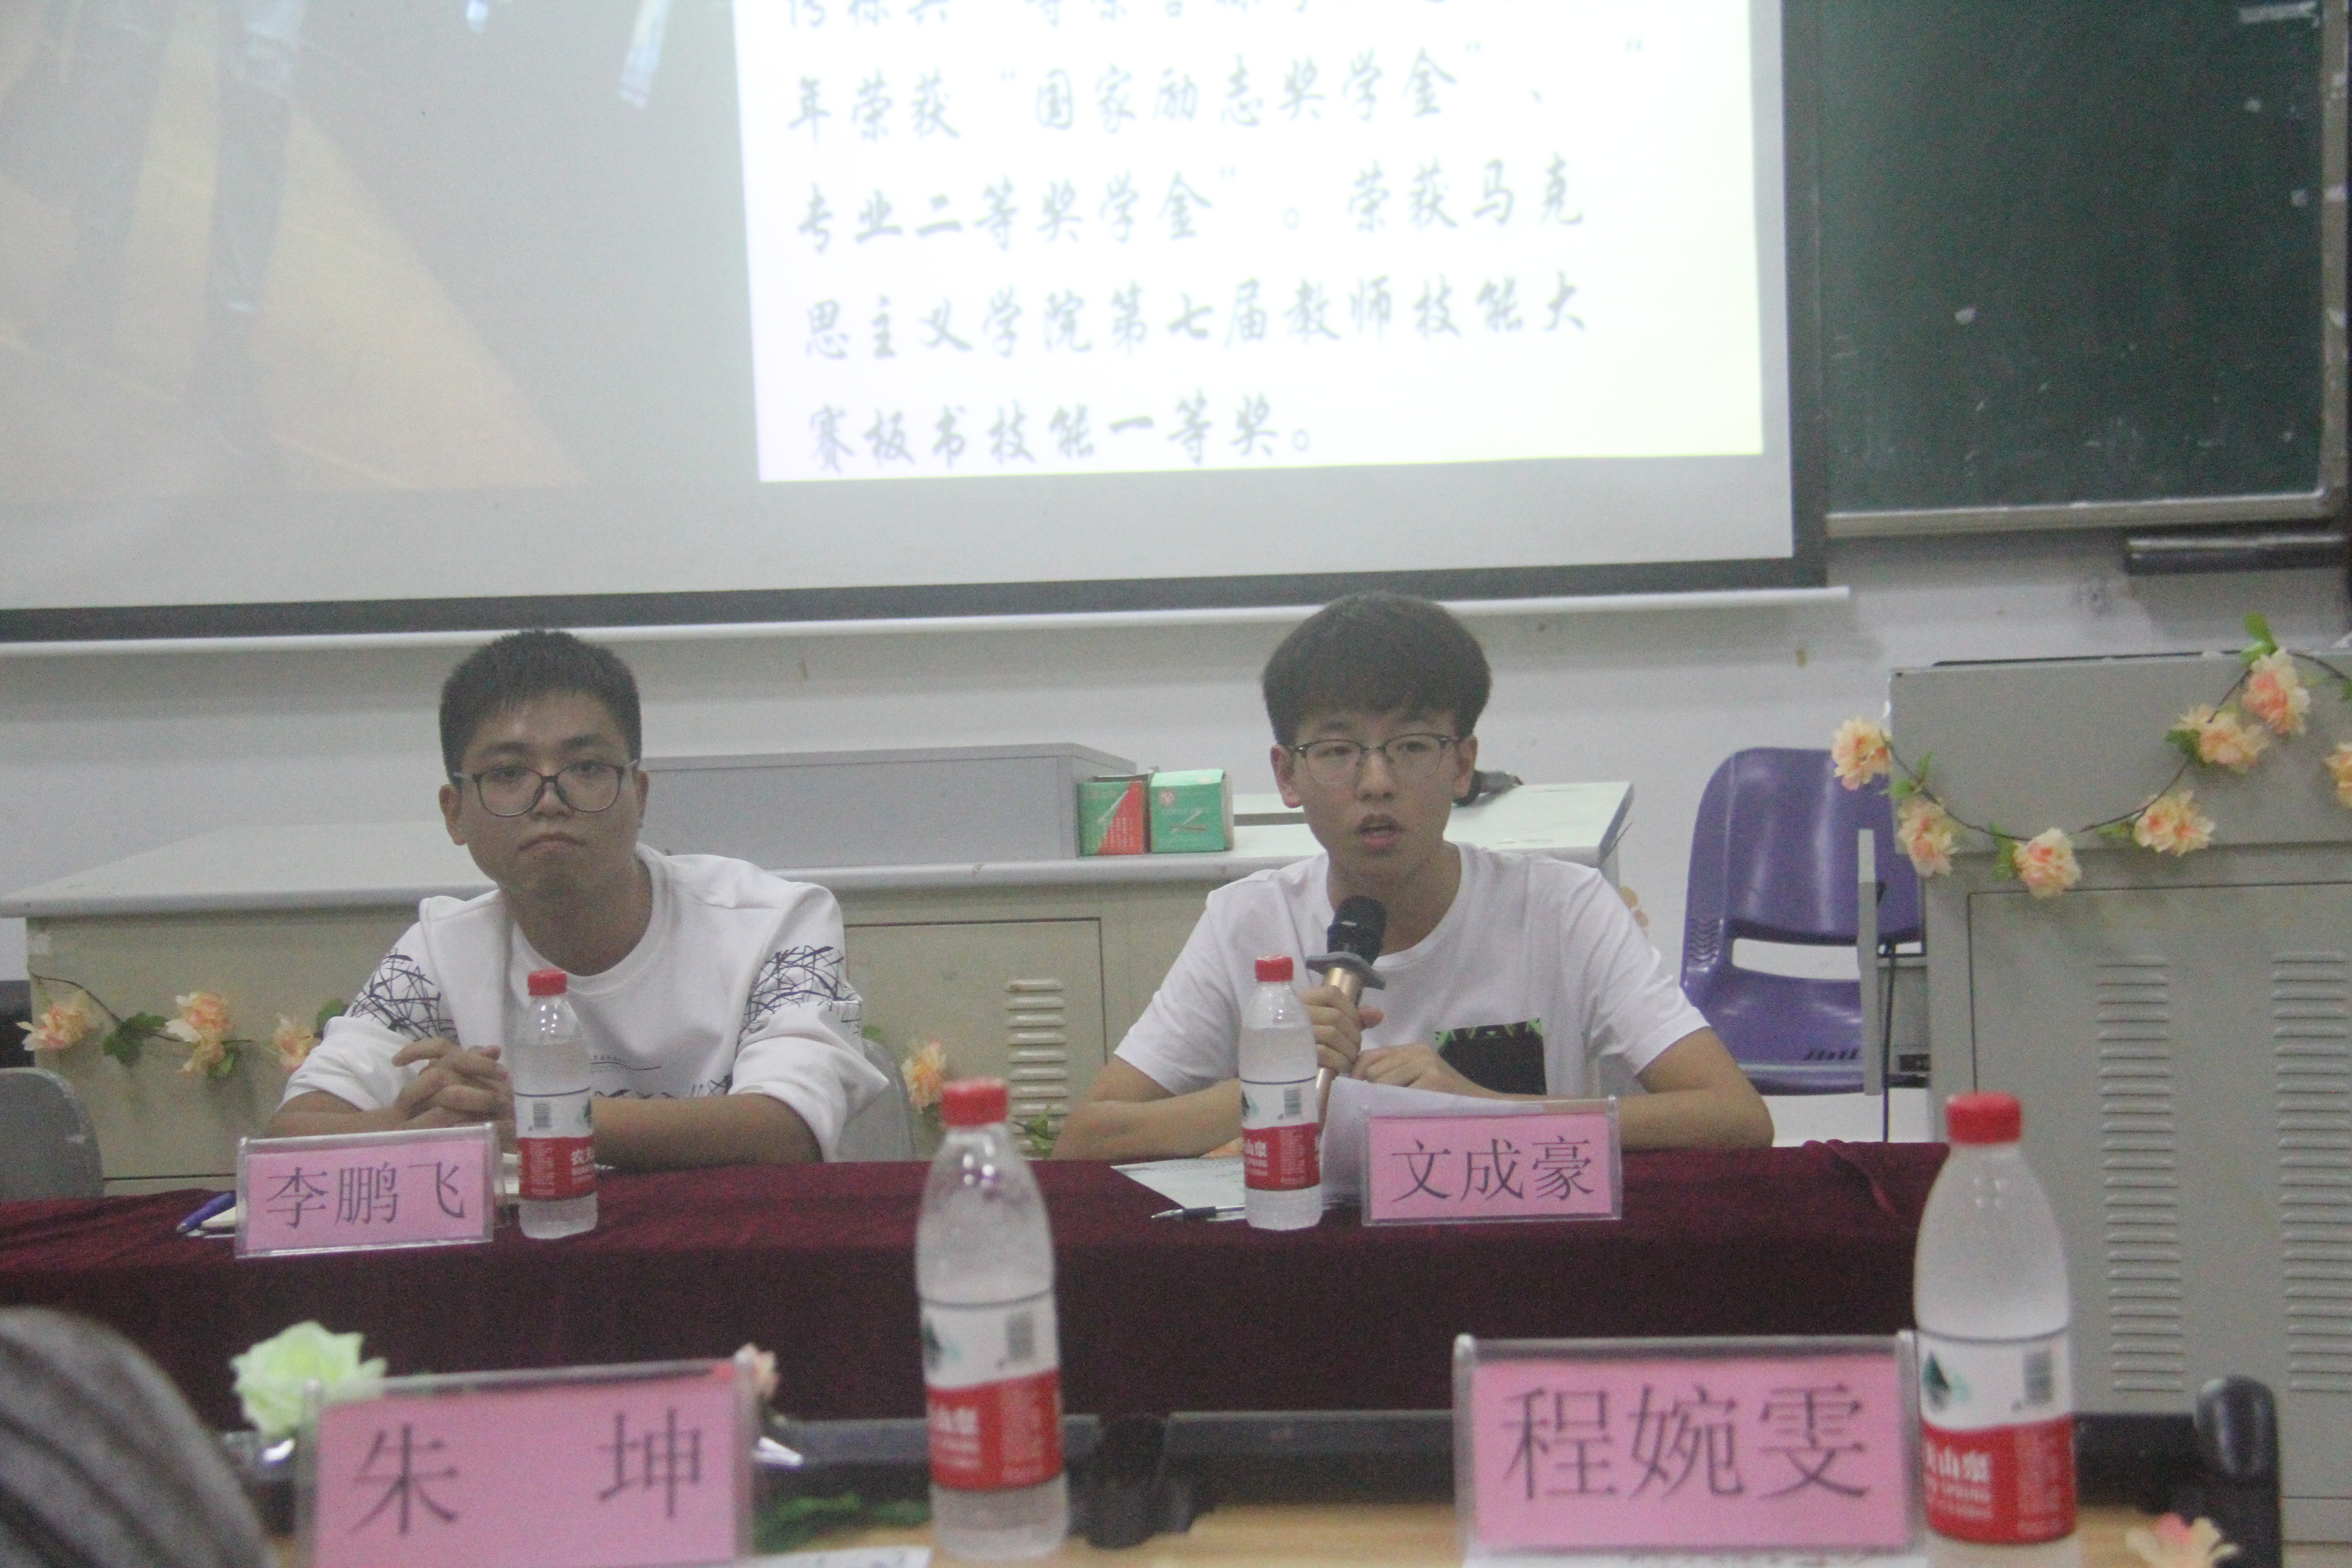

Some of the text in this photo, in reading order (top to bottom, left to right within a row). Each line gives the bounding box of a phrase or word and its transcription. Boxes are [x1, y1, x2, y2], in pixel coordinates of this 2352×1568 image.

[806, 270, 1587, 361] 思主义学院第七届教师技能大
[810, 389, 1310, 473] 赛板书技能一等奖。
[265, 1161, 466, 1229] 李鹏飞
[1391, 1136, 1596, 1203] 文成豪
[348, 1407, 703, 1534] 朱 坤
[1502, 1382, 1871, 1501] 程婉雯
